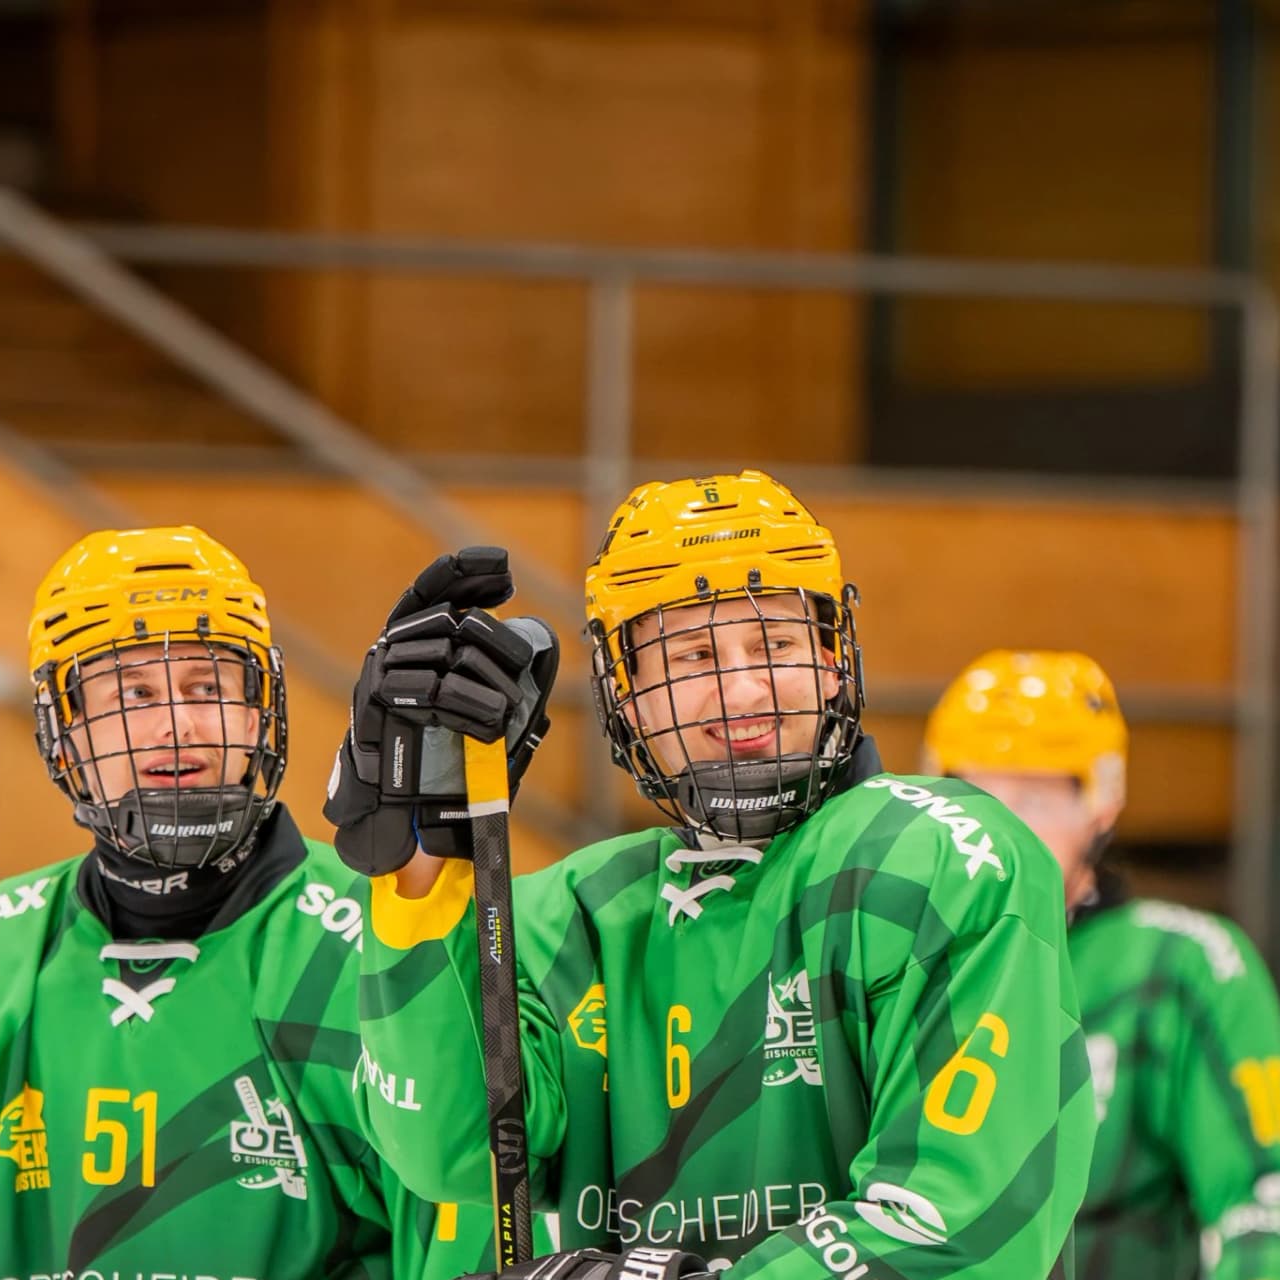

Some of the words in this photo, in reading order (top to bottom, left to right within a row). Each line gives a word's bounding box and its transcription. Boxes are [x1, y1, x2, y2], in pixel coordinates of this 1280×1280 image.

[704, 487, 720, 504] 6
[681, 528, 761, 547] WARRIOR
[128, 588, 209, 605] CCM
[710, 789, 797, 809] WARRIOR
[151, 820, 234, 838] WARRIOR
[864, 778, 1004, 881] SONAX
[666, 1004, 692, 1109] 6
[923, 1012, 1010, 1135] 6
[82, 1087, 158, 1187] 51
[501, 1203, 514, 1266] ALPHA
